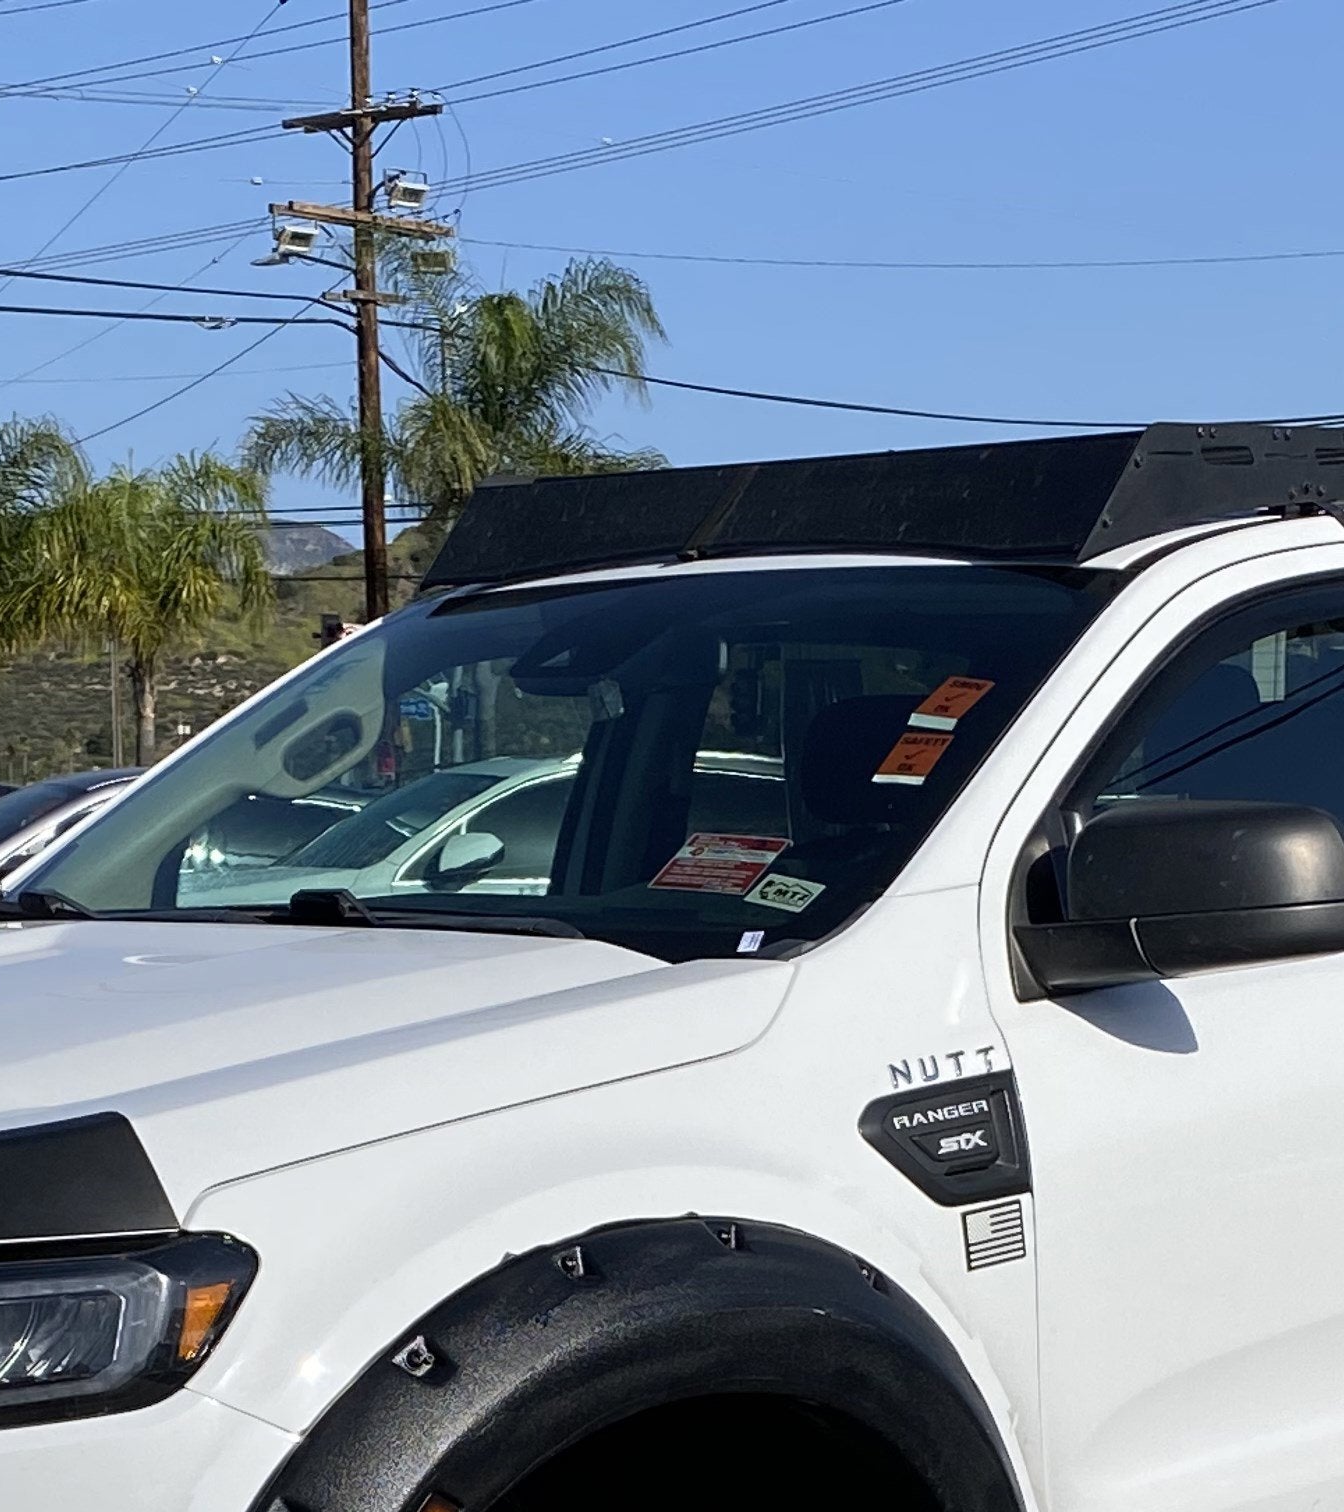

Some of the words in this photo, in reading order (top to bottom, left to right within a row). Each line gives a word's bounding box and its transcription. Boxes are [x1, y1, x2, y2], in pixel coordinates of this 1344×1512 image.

[900, 736, 951, 746] SAFETY
[888, 1045, 995, 1089] NUTT
[893, 1099, 989, 1130] RANGER
[938, 1129, 988, 1155] STX
